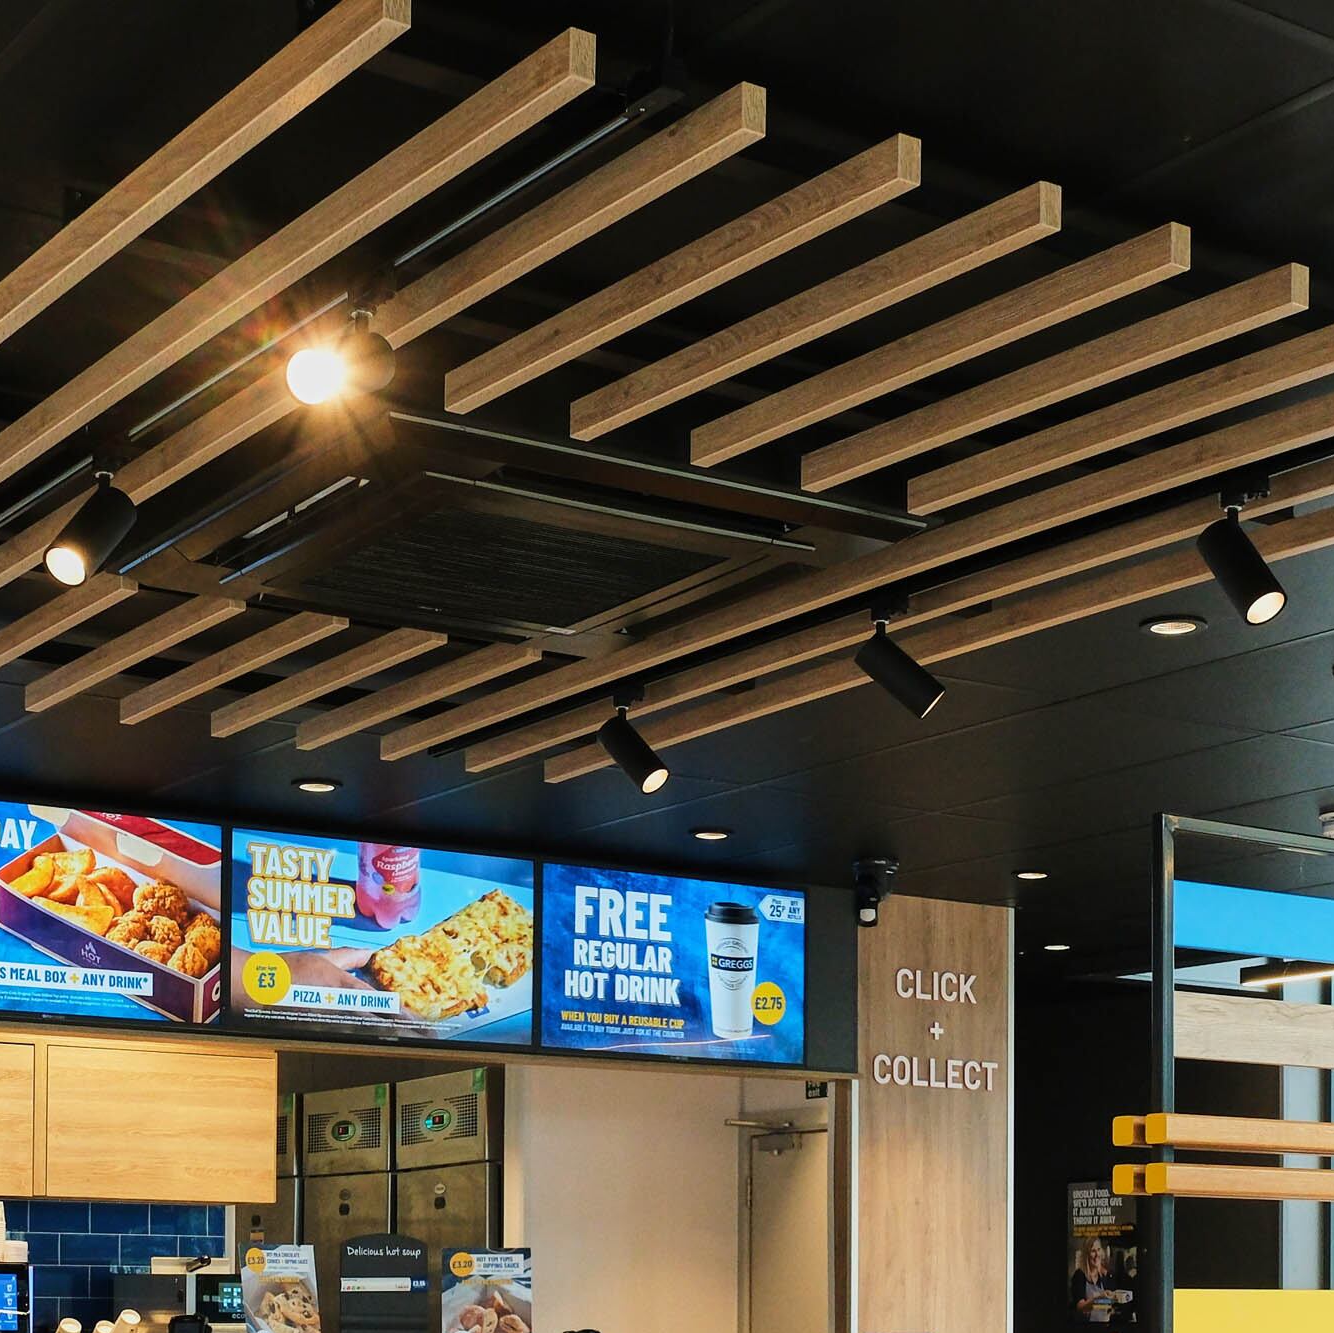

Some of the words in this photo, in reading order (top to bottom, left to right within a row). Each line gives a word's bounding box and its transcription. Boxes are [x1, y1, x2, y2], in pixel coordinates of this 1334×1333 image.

[248, 843, 335, 882] TASTY
[248, 877, 355, 917] SUMMER
[575, 885, 672, 942] FREE
[248, 909, 331, 948] VALUE
[573, 938, 673, 974] REGULAR
[718, 958, 753, 970] GREGGS
[10, 967, 41, 982] MEAL
[44, 969, 67, 984] BOX
[82, 973, 106, 987] ANY
[258, 973, 276, 988] £3
[896, 968, 977, 1005] CLICK
[564, 969, 610, 1000] HOT
[614, 974, 681, 1007] DRINK
[293, 991, 322, 1004] PIZZA
[337, 995, 359, 1006] ANY
[755, 997, 782, 1010] £2.75
[561, 1010, 585, 1022] WHEN
[586, 1012, 602, 1024] YOU
[604, 1014, 620, 1025] BUY
[621, 1015, 627, 1026] A
[628, 1016, 666, 1029] REUSABLE
[667, 1018, 685, 1030] CUP
[873, 1054, 999, 1092] COLLECT
[1110, 1197, 1123, 1206] GIVE
[247, 1256, 265, 1265] £3.20
[347, 1246, 383, 1256] Delicious
[386, 1245, 400, 1256] hot
[402, 1249, 421, 1259] soup
[452, 1261, 473, 1269] £3.20
